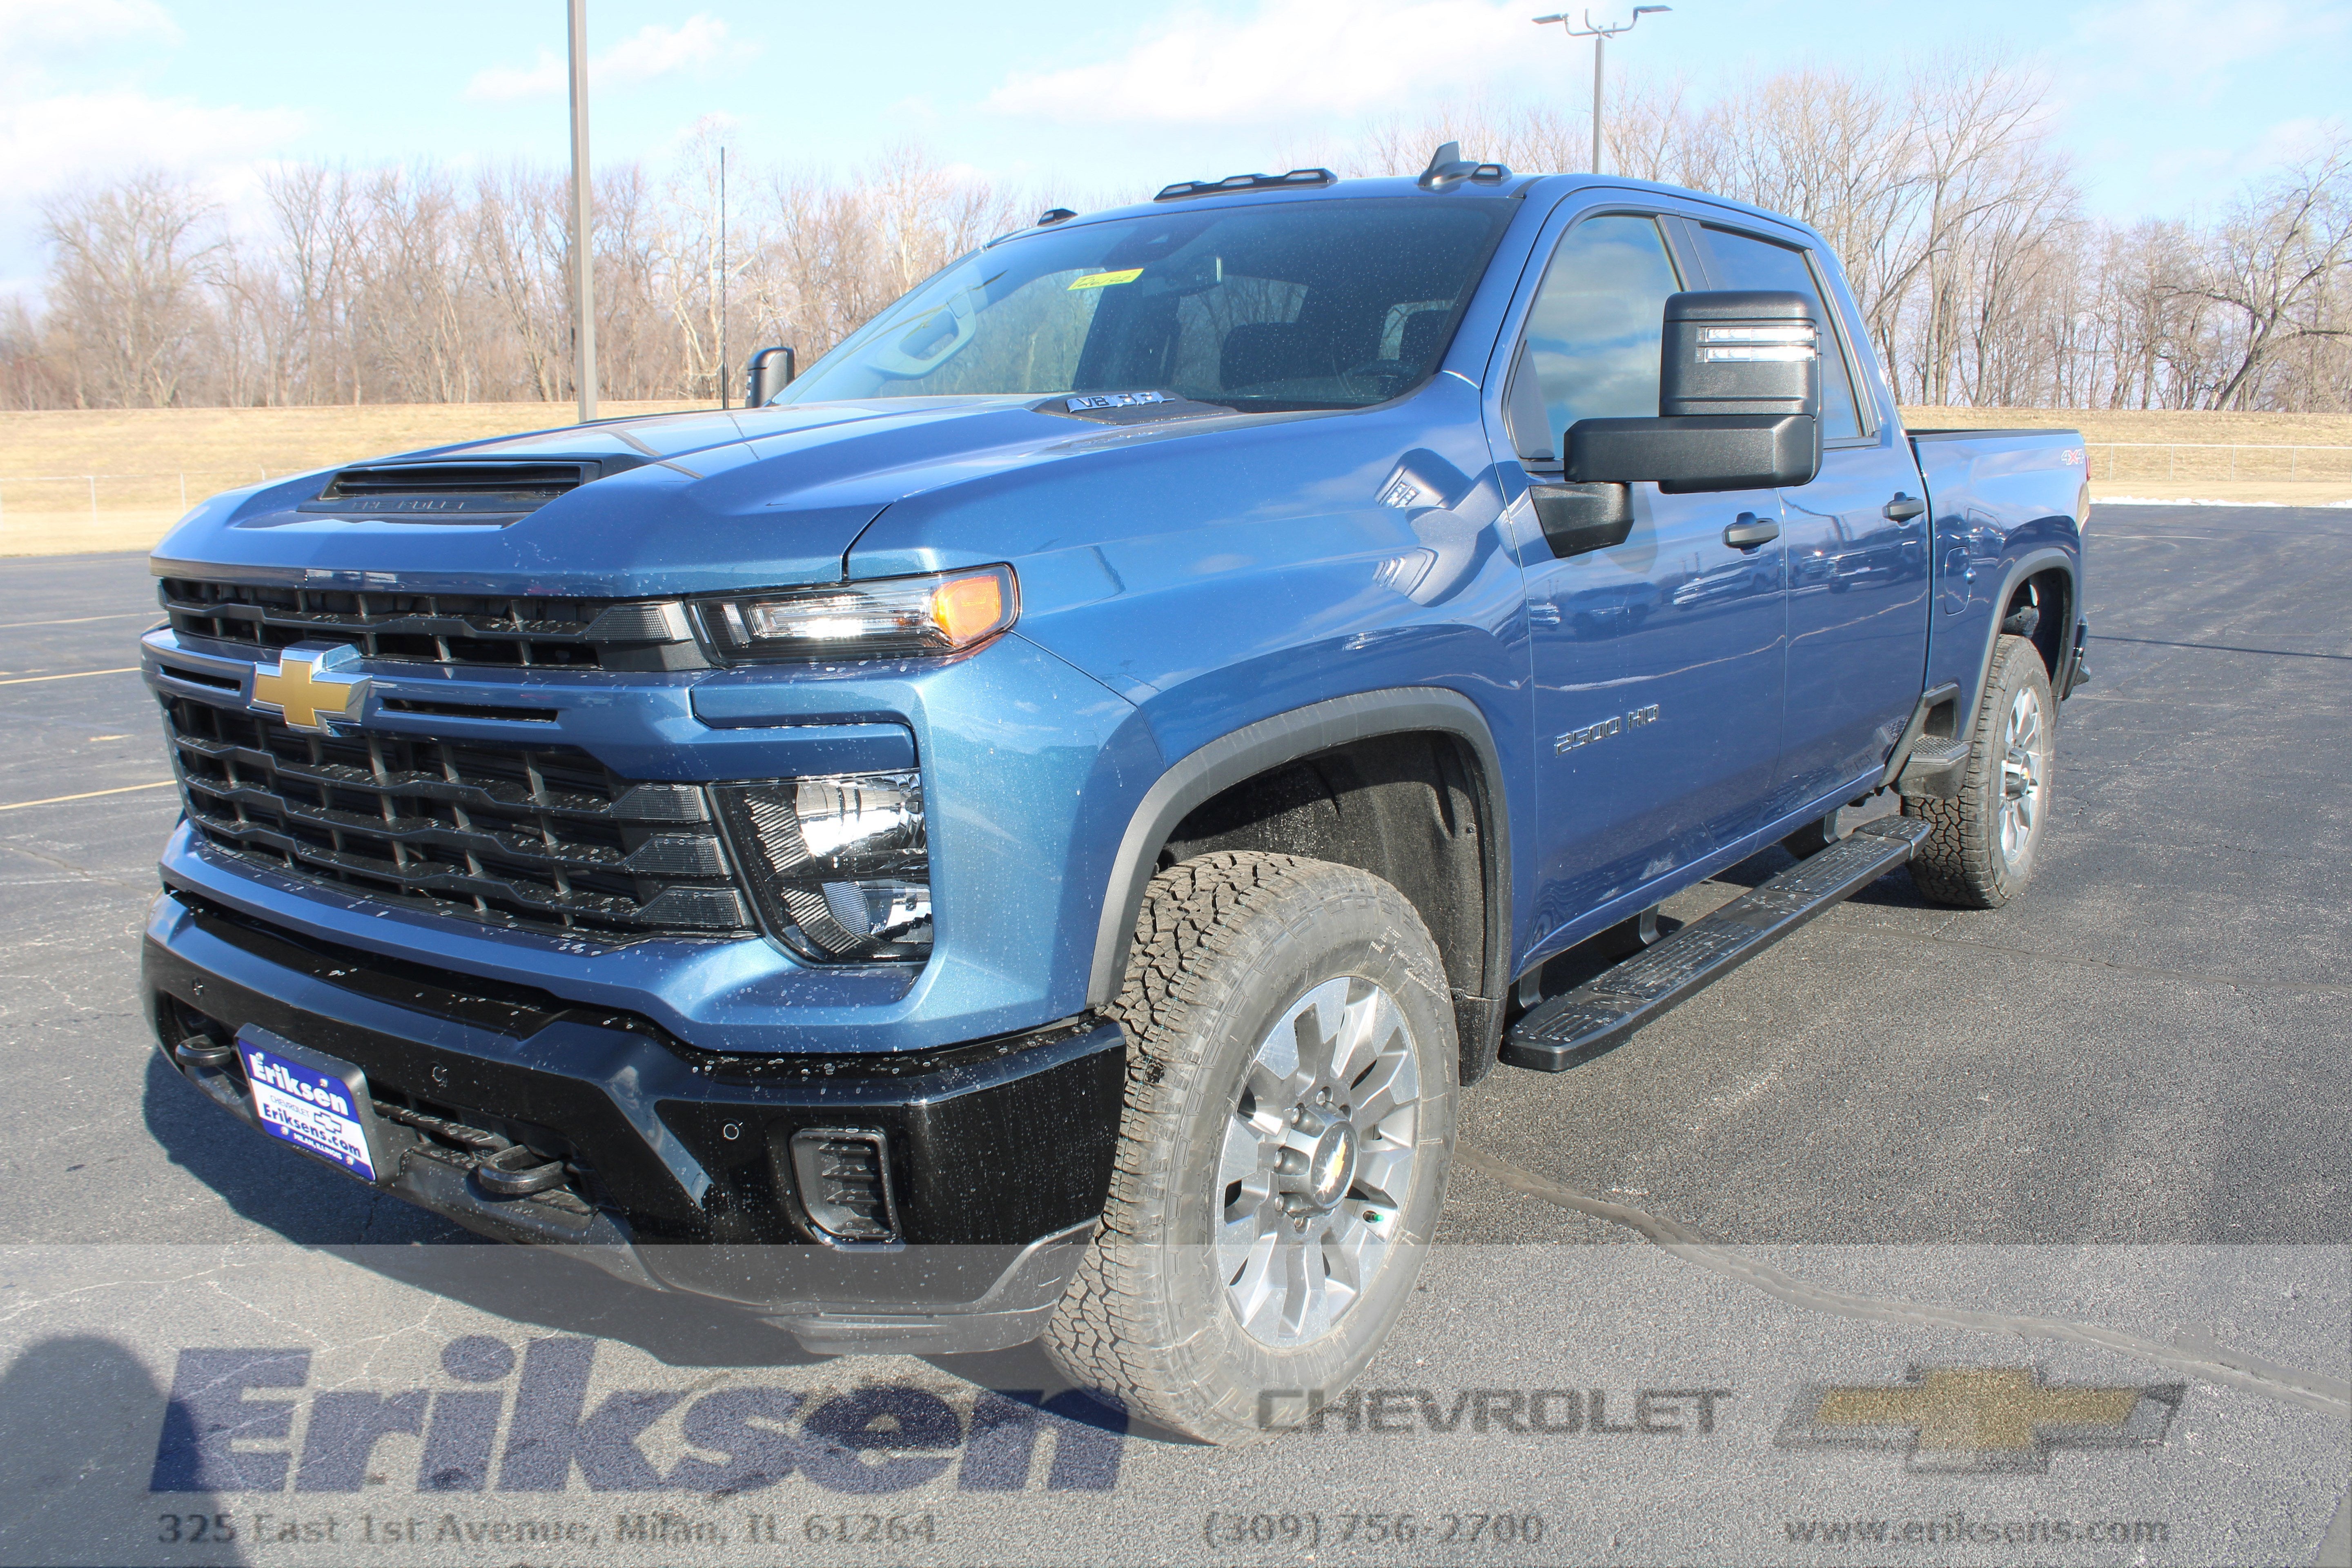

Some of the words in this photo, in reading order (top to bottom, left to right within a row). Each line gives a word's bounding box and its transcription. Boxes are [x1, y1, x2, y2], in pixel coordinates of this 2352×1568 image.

[353, 500, 472, 510] CHEVROLET
[1554, 715, 1621, 756] 2500
[1626, 703, 1659, 733] HD
[249, 1054, 349, 1116] Eriksen
[270, 1095, 310, 1118] CHEVROLET
[263, 1102, 361, 1158] Eriksens.com
